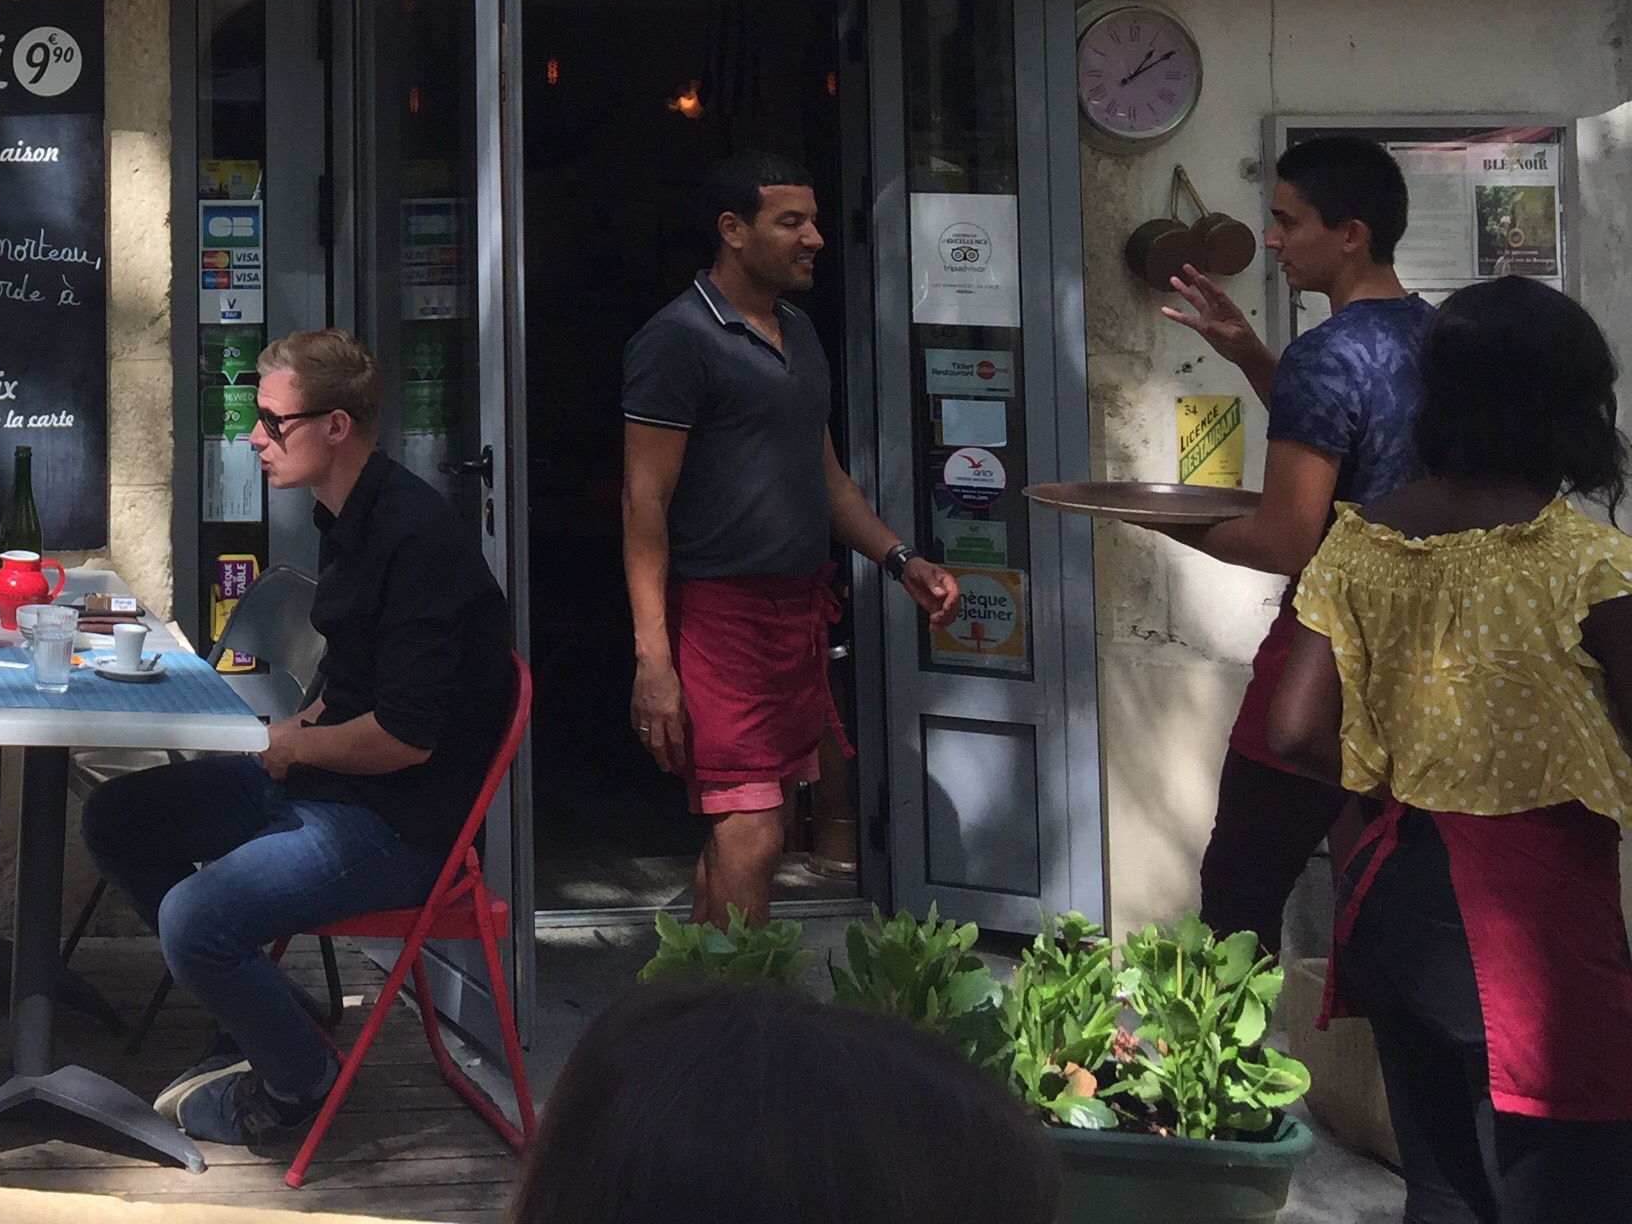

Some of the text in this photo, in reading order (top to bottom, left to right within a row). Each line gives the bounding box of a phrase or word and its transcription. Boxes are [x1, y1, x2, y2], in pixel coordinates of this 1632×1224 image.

[235, 252, 260, 262] VISA
[235, 272, 260, 283] VISA
[57, 275, 81, 307] à
[3, 410, 25, 427] la
[27, 410, 74, 428] carte
[1184, 404, 1198, 416] 34
[1180, 404, 1220, 453] LICENCE
[236, 562, 247, 596] TABLE
